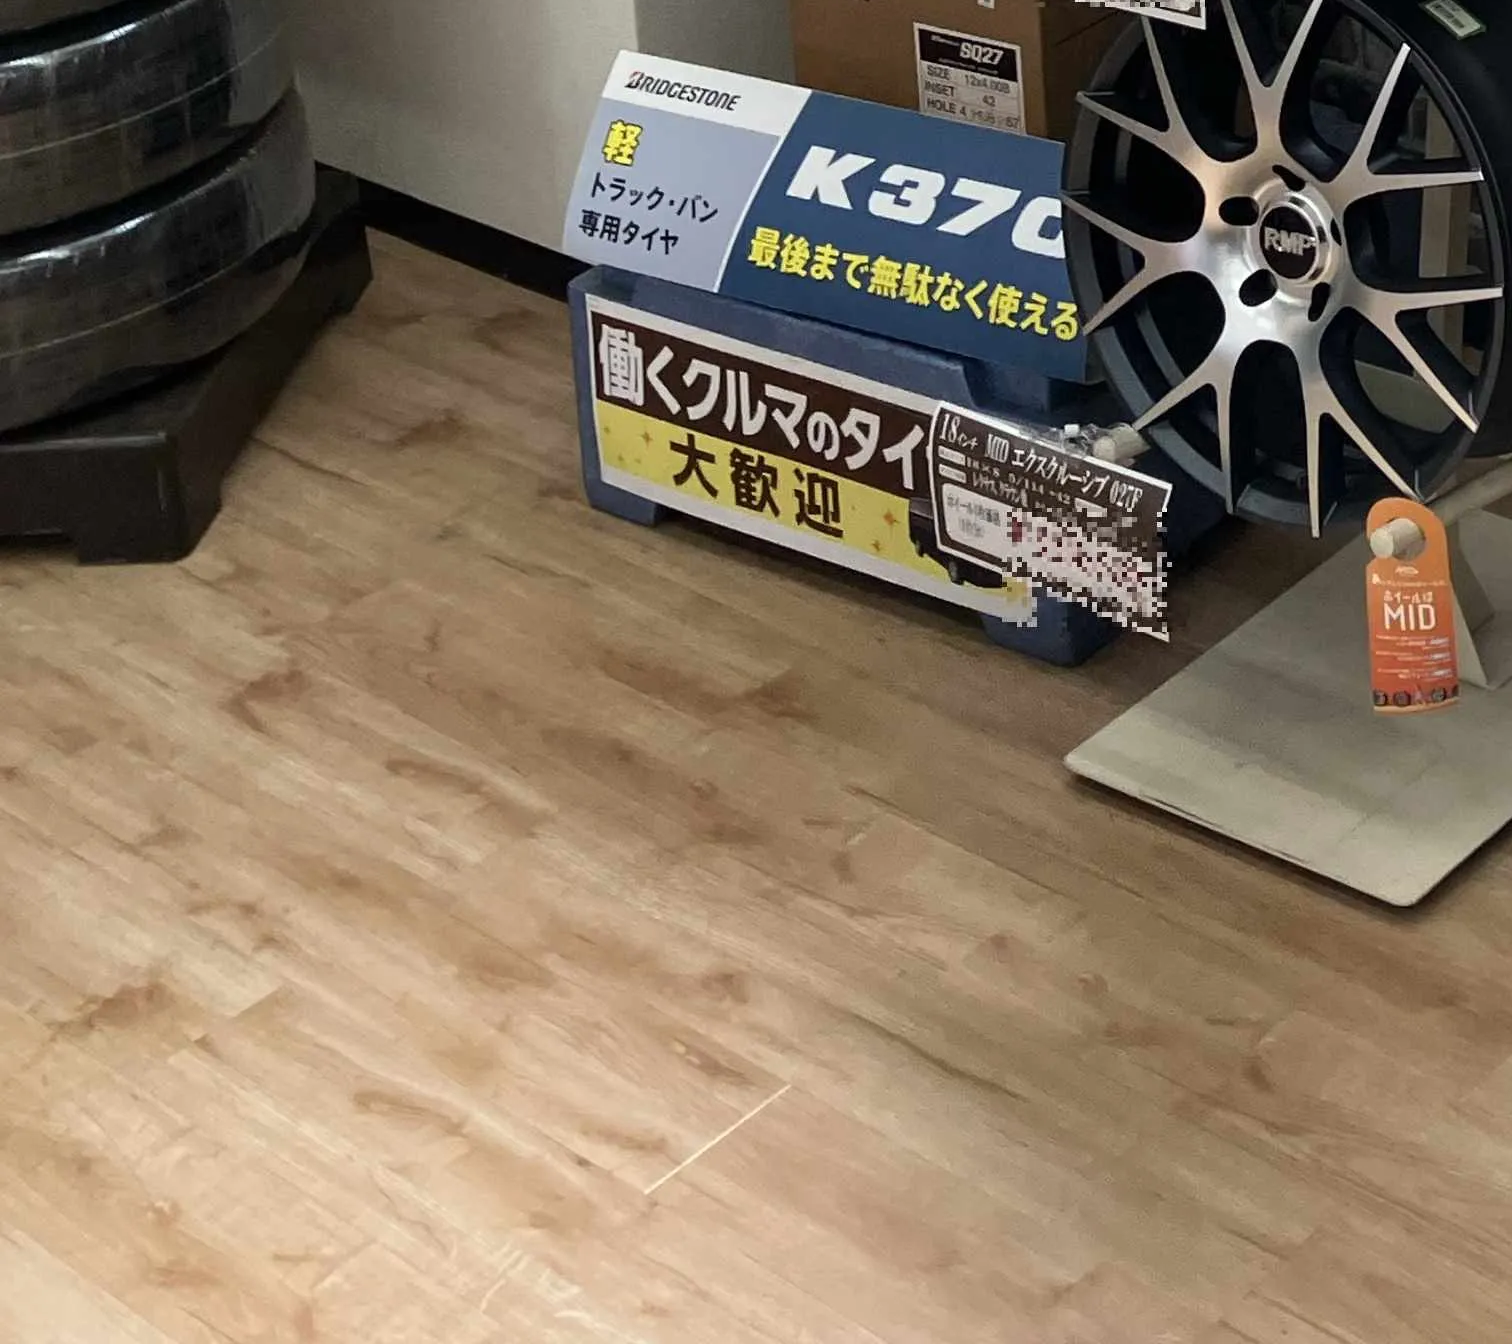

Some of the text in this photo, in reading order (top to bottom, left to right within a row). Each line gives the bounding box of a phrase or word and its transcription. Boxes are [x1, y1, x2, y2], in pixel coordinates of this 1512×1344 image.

[959, 41, 1005, 66] SQ27
[624, 70, 742, 112] BRIDGESTONE
[601, 118, 644, 168] 軽
[590, 171, 719, 224] トラック・バン
[578, 208, 680, 256] 専用タイヤ
[747, 224, 1080, 343] 最後まで無駄なく使える
[598, 322, 933, 494] 働くクルマのタイ
[668, 432, 847, 541] 大歓迎
[1383, 602, 1436, 632] MID
